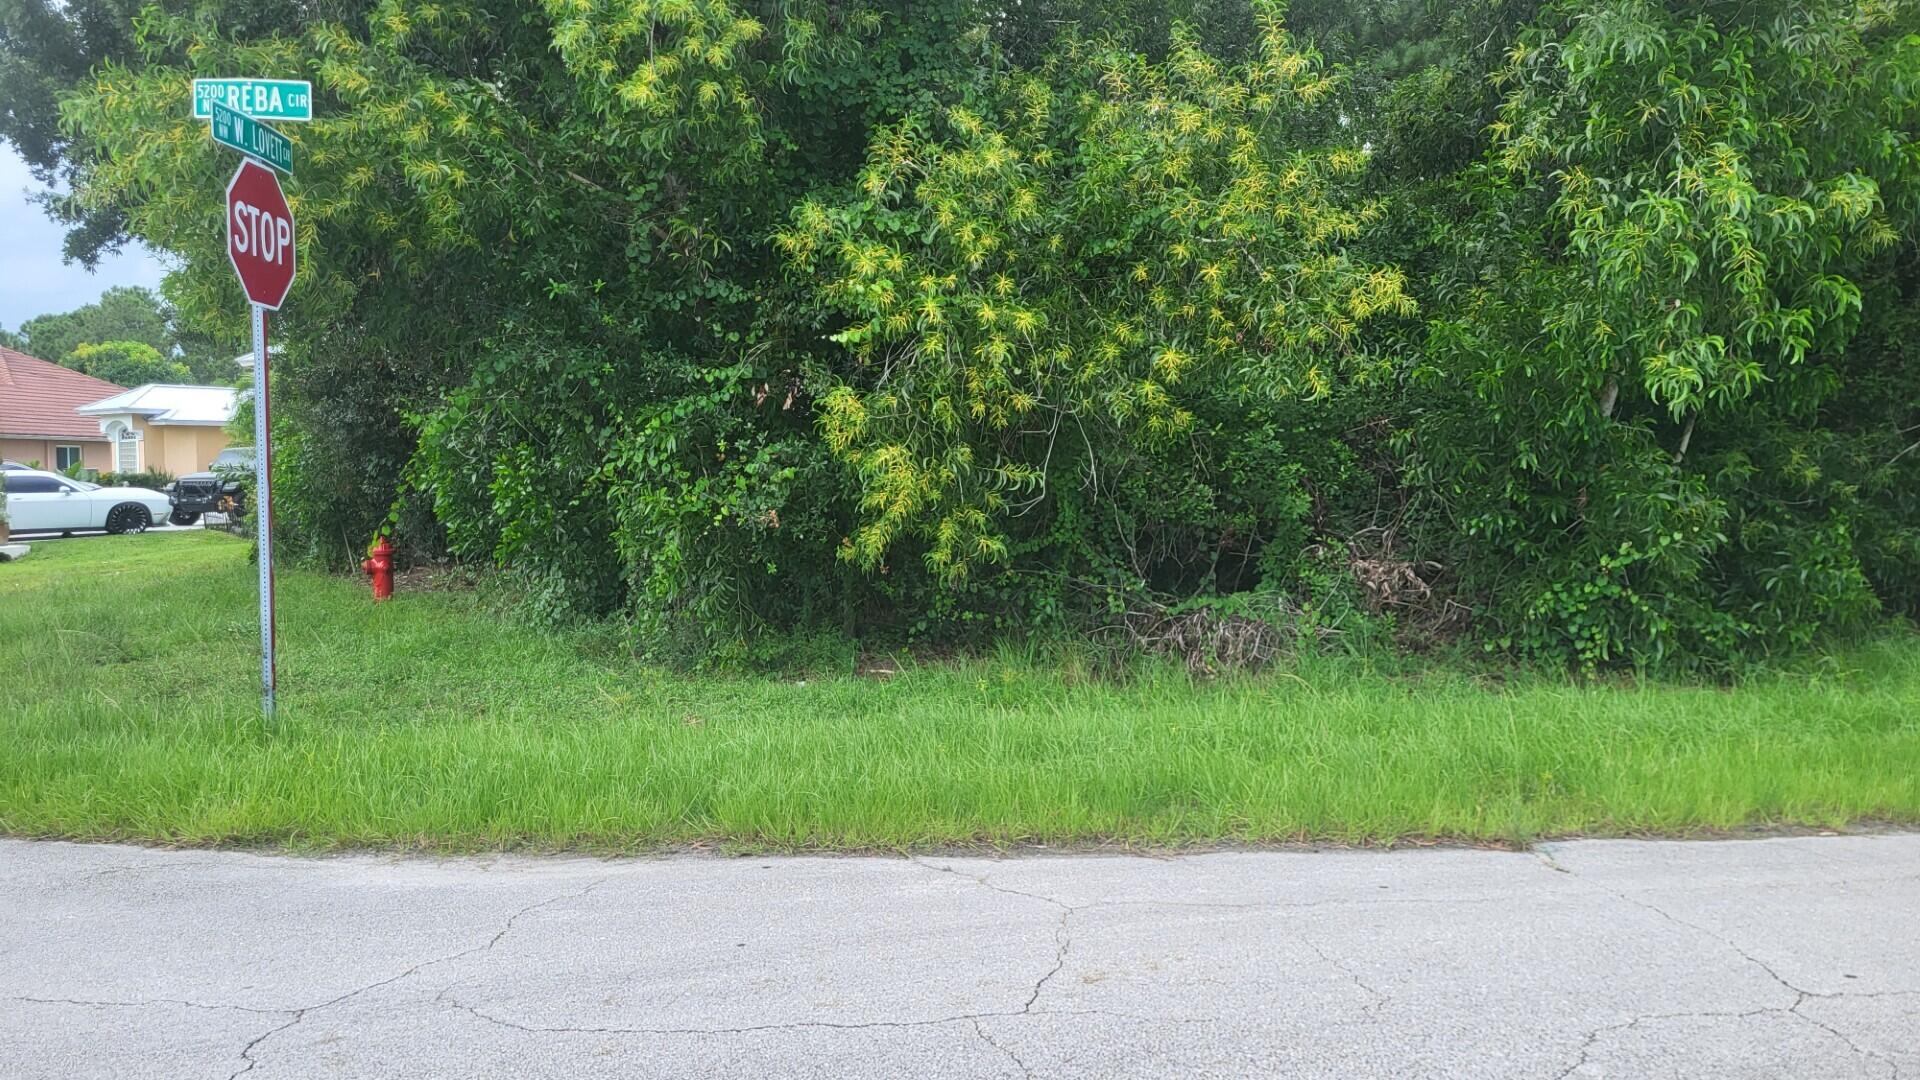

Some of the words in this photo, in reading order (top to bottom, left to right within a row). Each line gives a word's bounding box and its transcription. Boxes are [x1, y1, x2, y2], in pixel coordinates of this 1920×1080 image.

[197, 84, 224, 98] 5200
[227, 85, 284, 113] REBA
[288, 93, 307, 108] CIR
[252, 124, 283, 164] LOVETT
[234, 200, 290, 265] STOP
